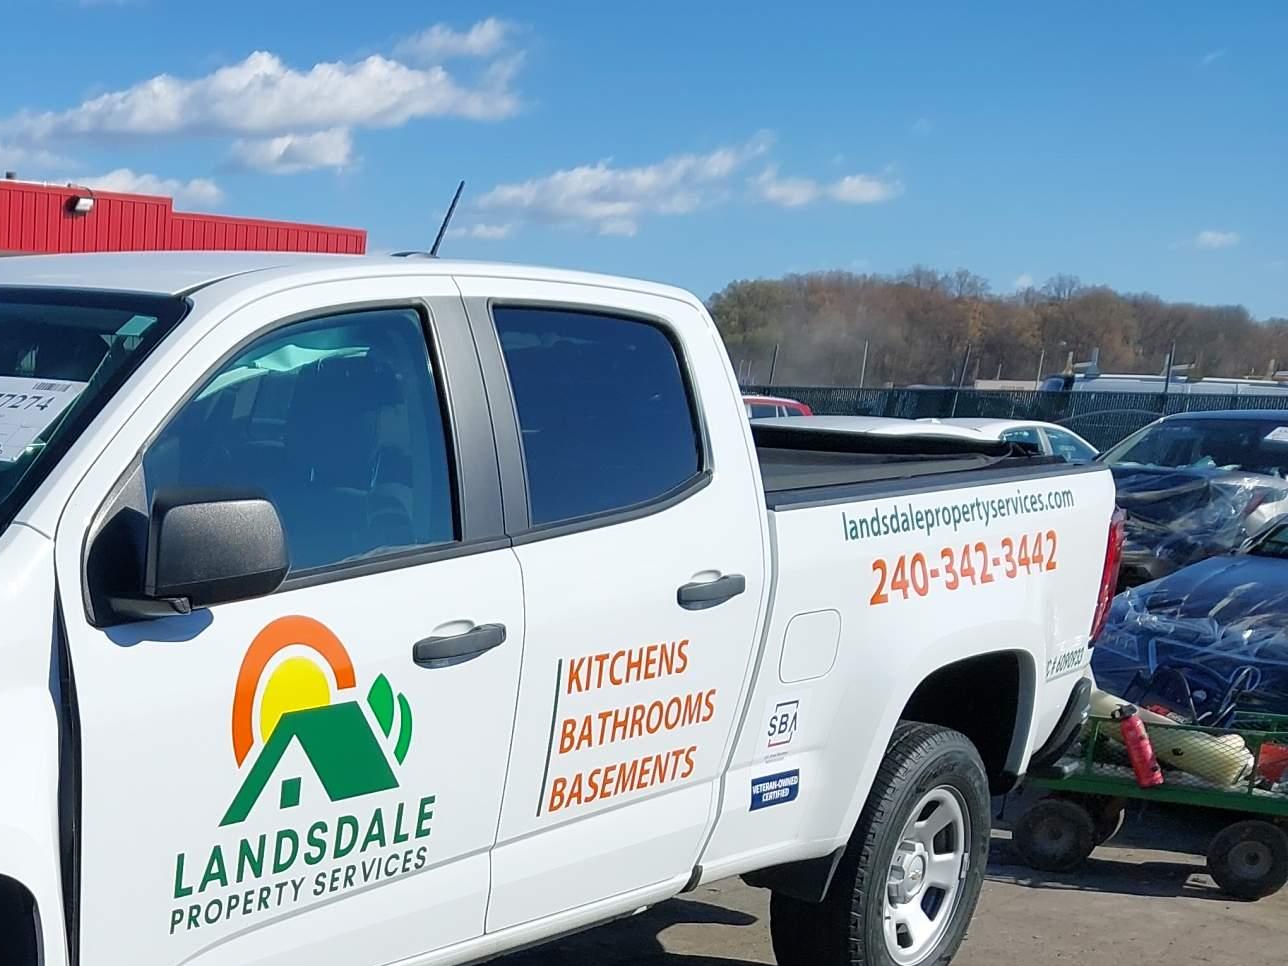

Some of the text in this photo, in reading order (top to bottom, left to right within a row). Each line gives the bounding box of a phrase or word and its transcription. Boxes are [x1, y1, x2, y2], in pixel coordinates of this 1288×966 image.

[842, 488, 1074, 541] landsdalepropertyservices.com
[870, 530, 1057, 605] 240-342-3442
[567, 639, 689, 694] KITCHENS
[559, 689, 716, 754] BATHROOMS
[767, 711, 798, 737] SBA
[548, 746, 697, 812] BASEMENTS
[752, 775, 799, 795] VETERAN-OWNED
[762, 787, 790, 802] CERTIFIED
[174, 795, 436, 899] LANDSDALE
[169, 846, 428, 935] PROPERTY SERVICES
